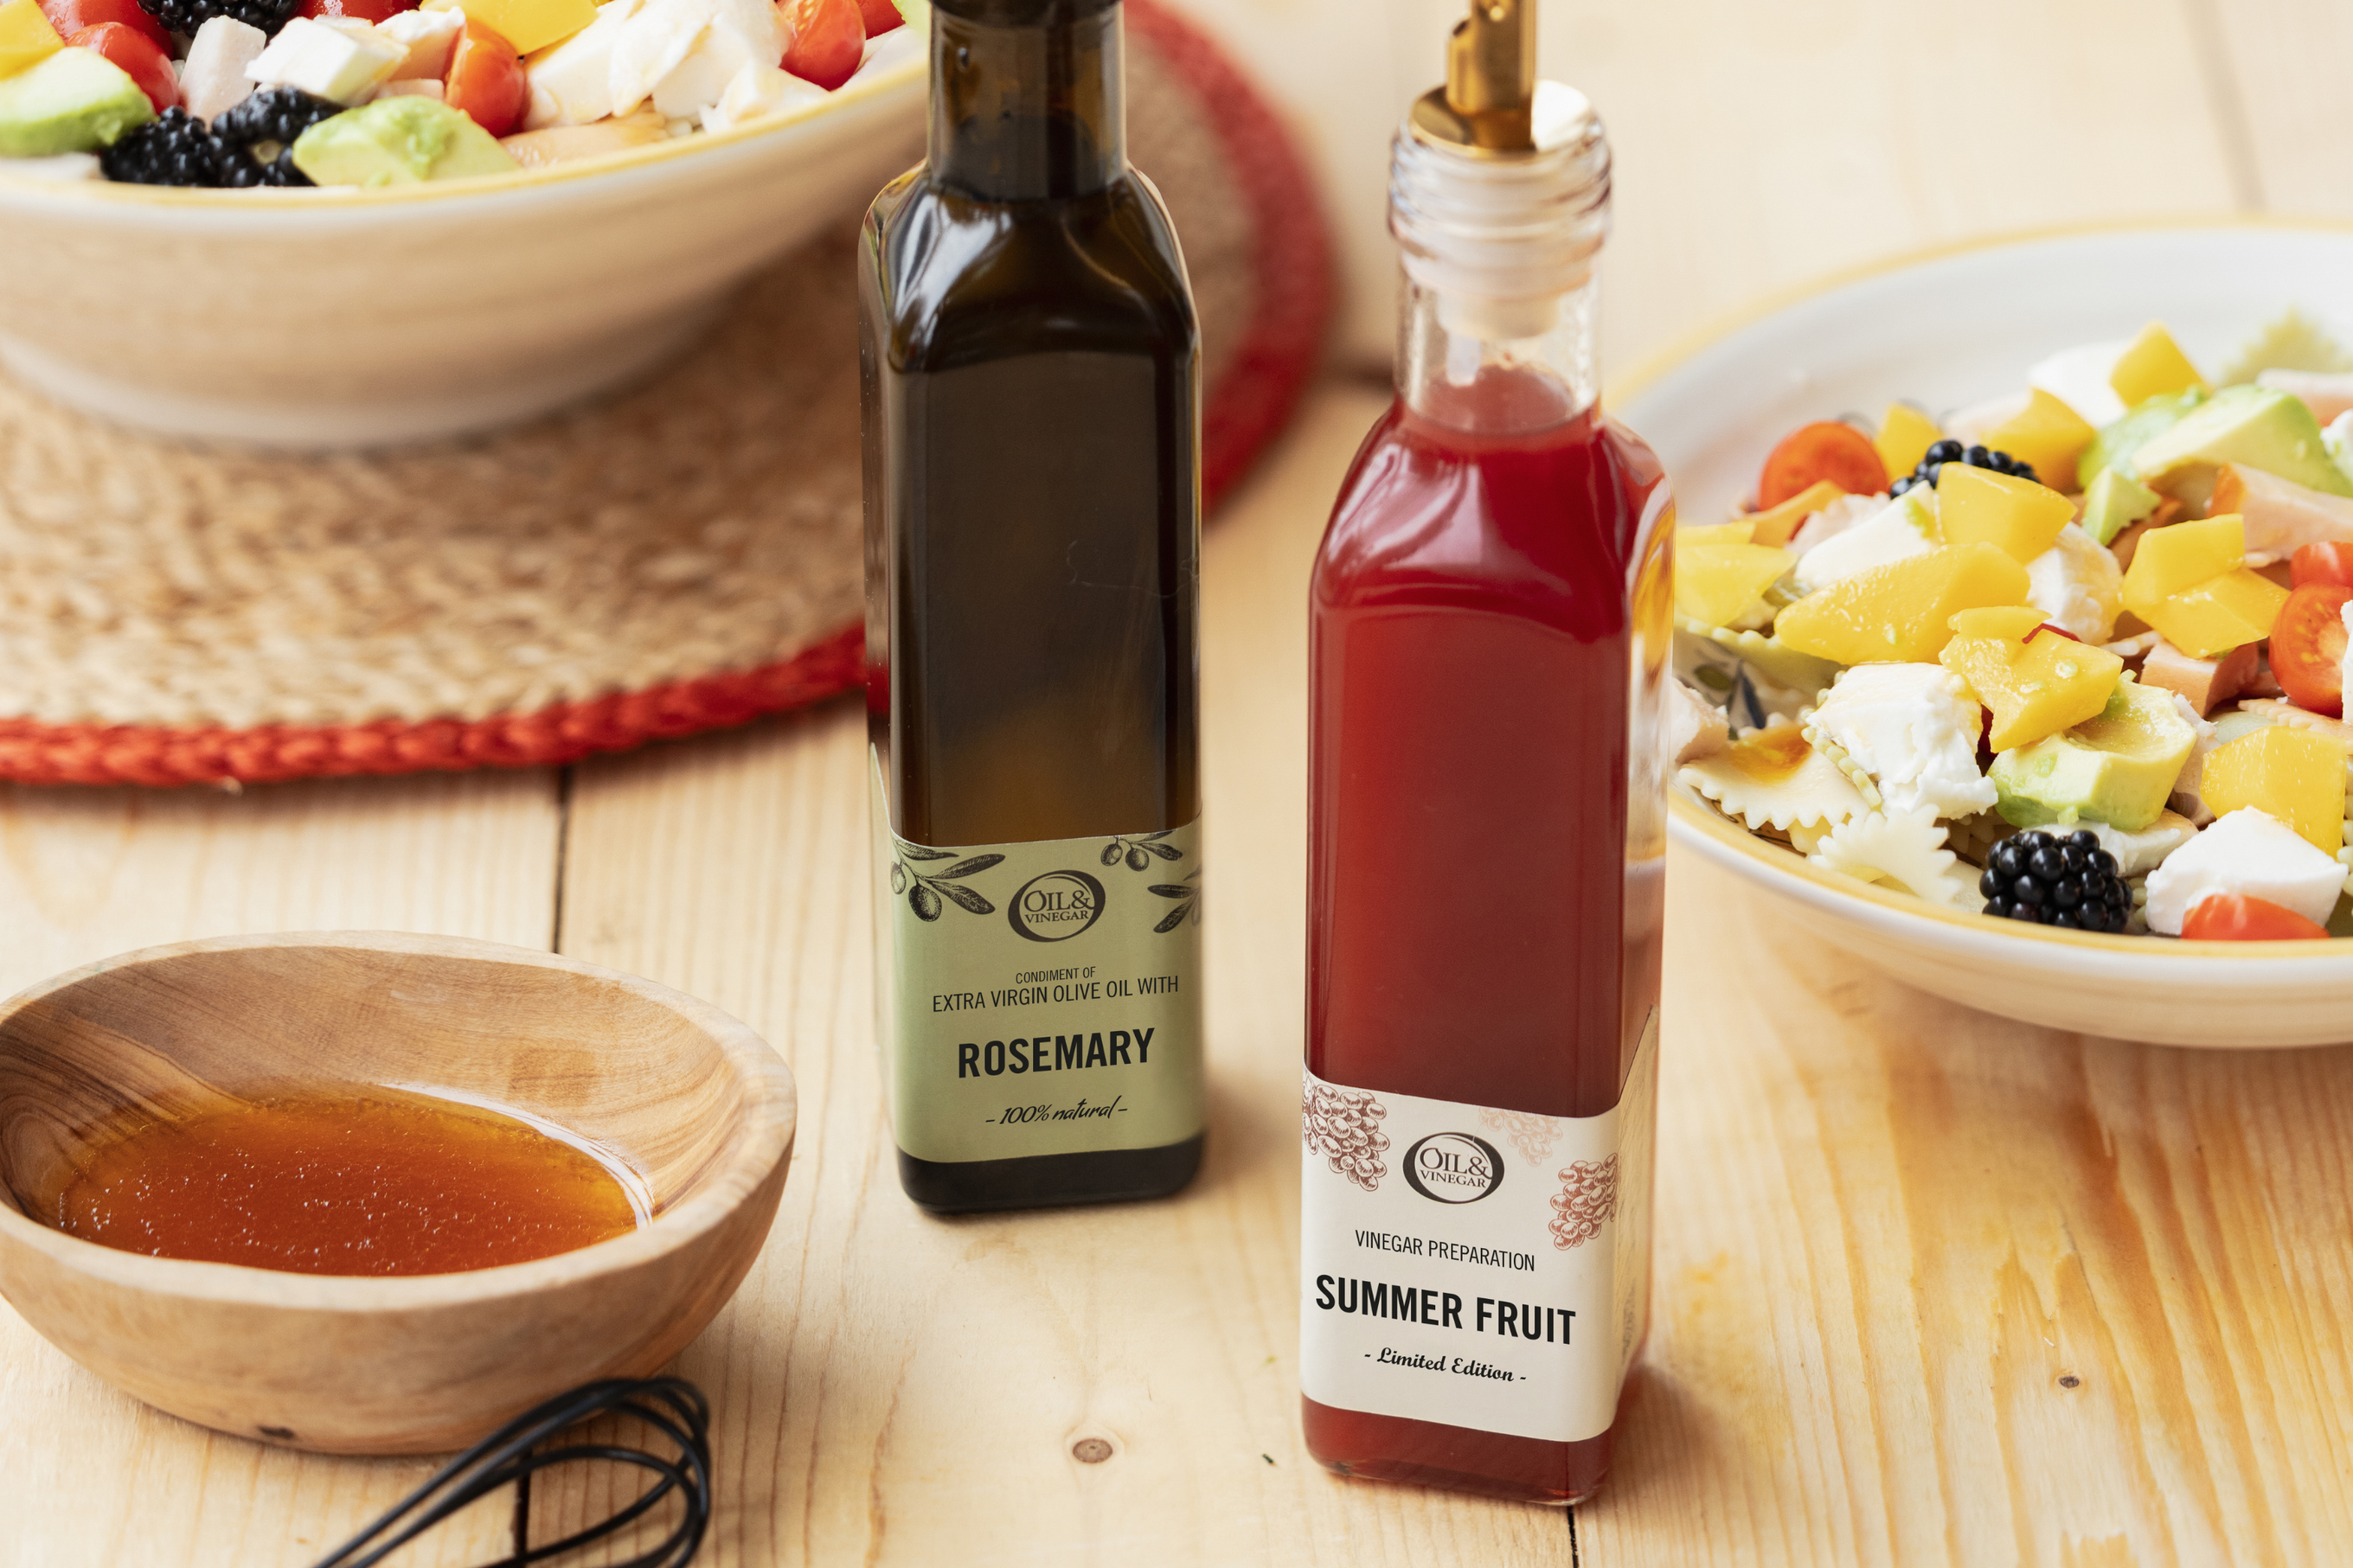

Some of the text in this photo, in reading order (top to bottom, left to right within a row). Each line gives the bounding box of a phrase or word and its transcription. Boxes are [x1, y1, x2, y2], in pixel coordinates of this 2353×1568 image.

[1024, 909, 1090, 924] VINEGAR
[1015, 966, 1096, 984] CONDIMENT OF
[933, 975, 1179, 1013] EXTRA VIRGIN OLIVE OIL WITH
[959, 1027, 1155, 1078] ROSEMARY
[1420, 1168, 1487, 1189] VINEGAR
[1355, 1229, 1535, 1272] VINEGAR PREPARATION
[1316, 1274, 1463, 1329] SUMMER
[1476, 1296, 1576, 1345] FRUIT
[1376, 1347, 1446, 1372] Limited
[1451, 1357, 1515, 1382] Edition
